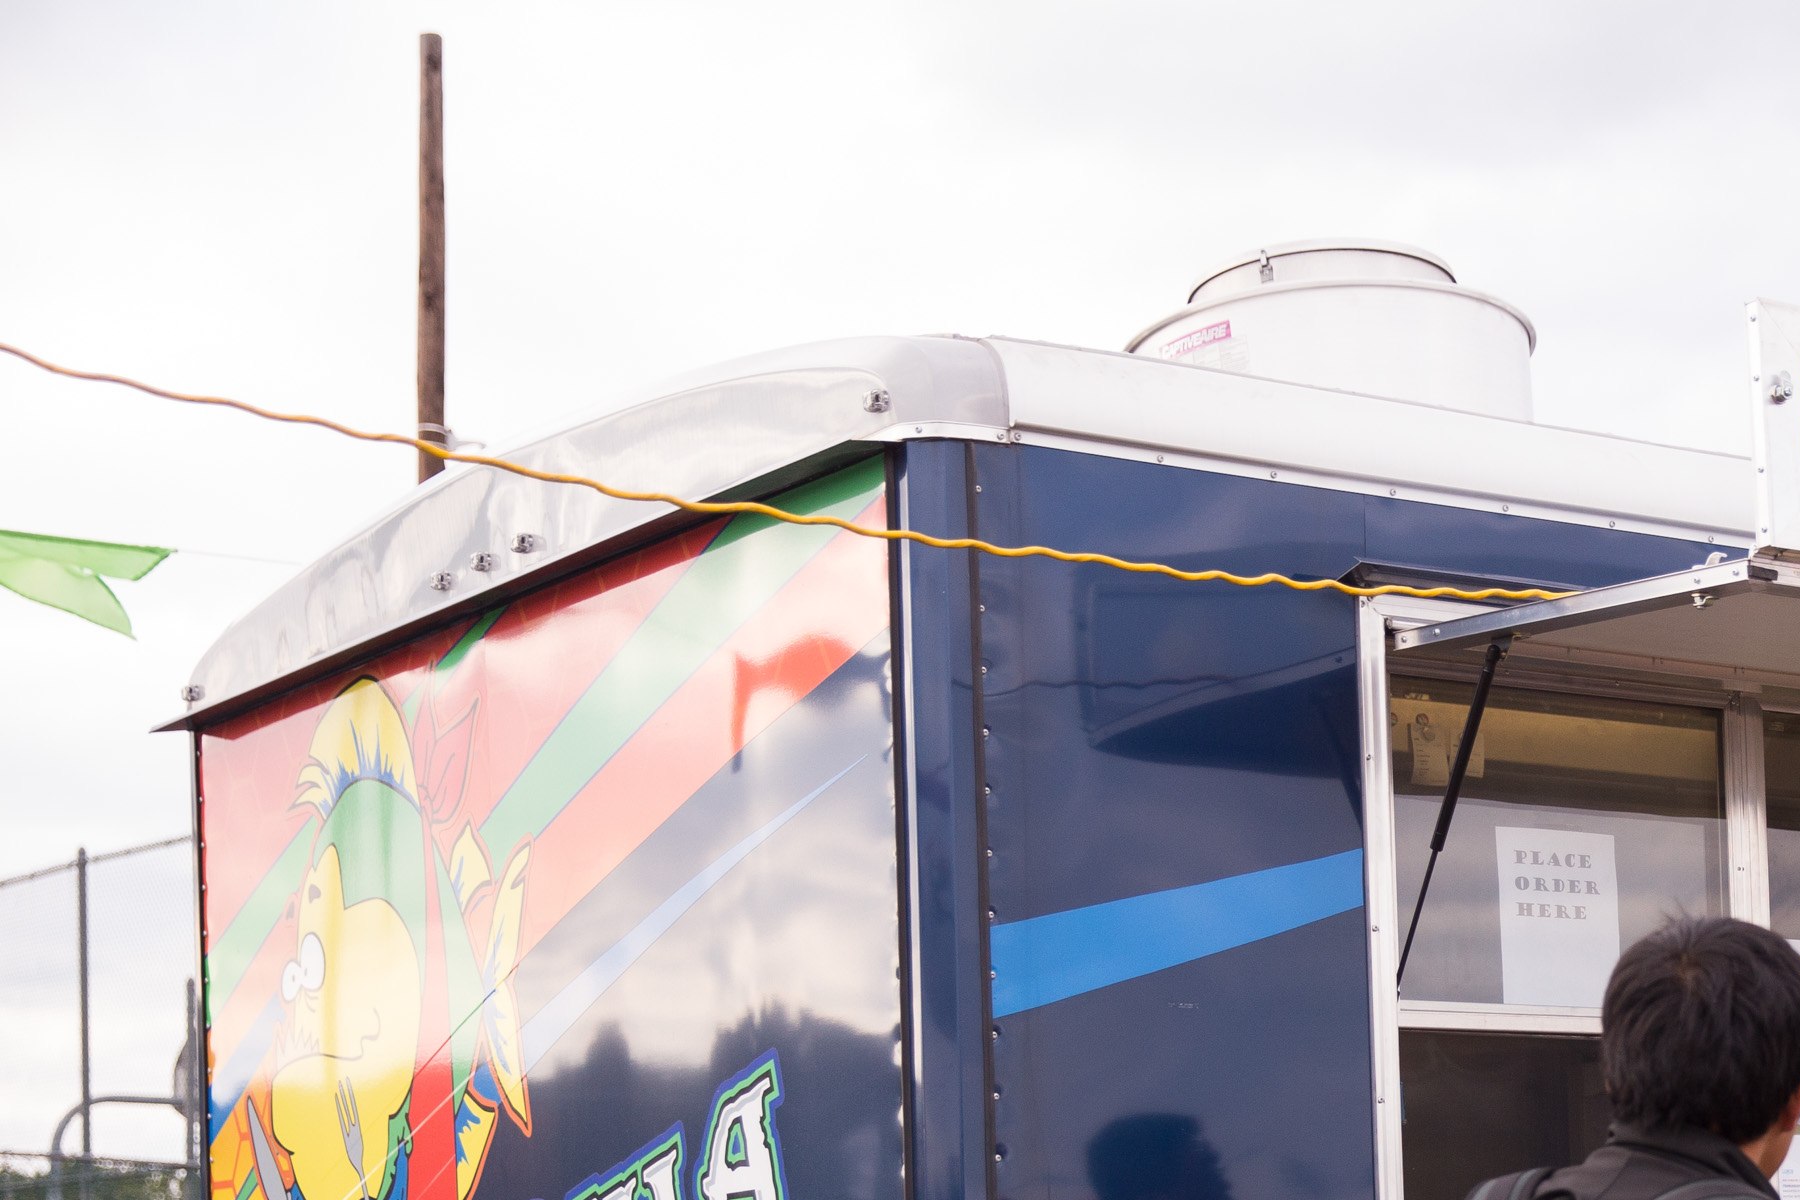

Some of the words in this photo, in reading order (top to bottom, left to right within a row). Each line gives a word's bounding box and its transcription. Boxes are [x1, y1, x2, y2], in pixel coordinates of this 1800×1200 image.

[1514, 850, 1592, 868] PLACE
[1514, 876, 1601, 895] ORDER
[1516, 902, 1587, 920] HERE
